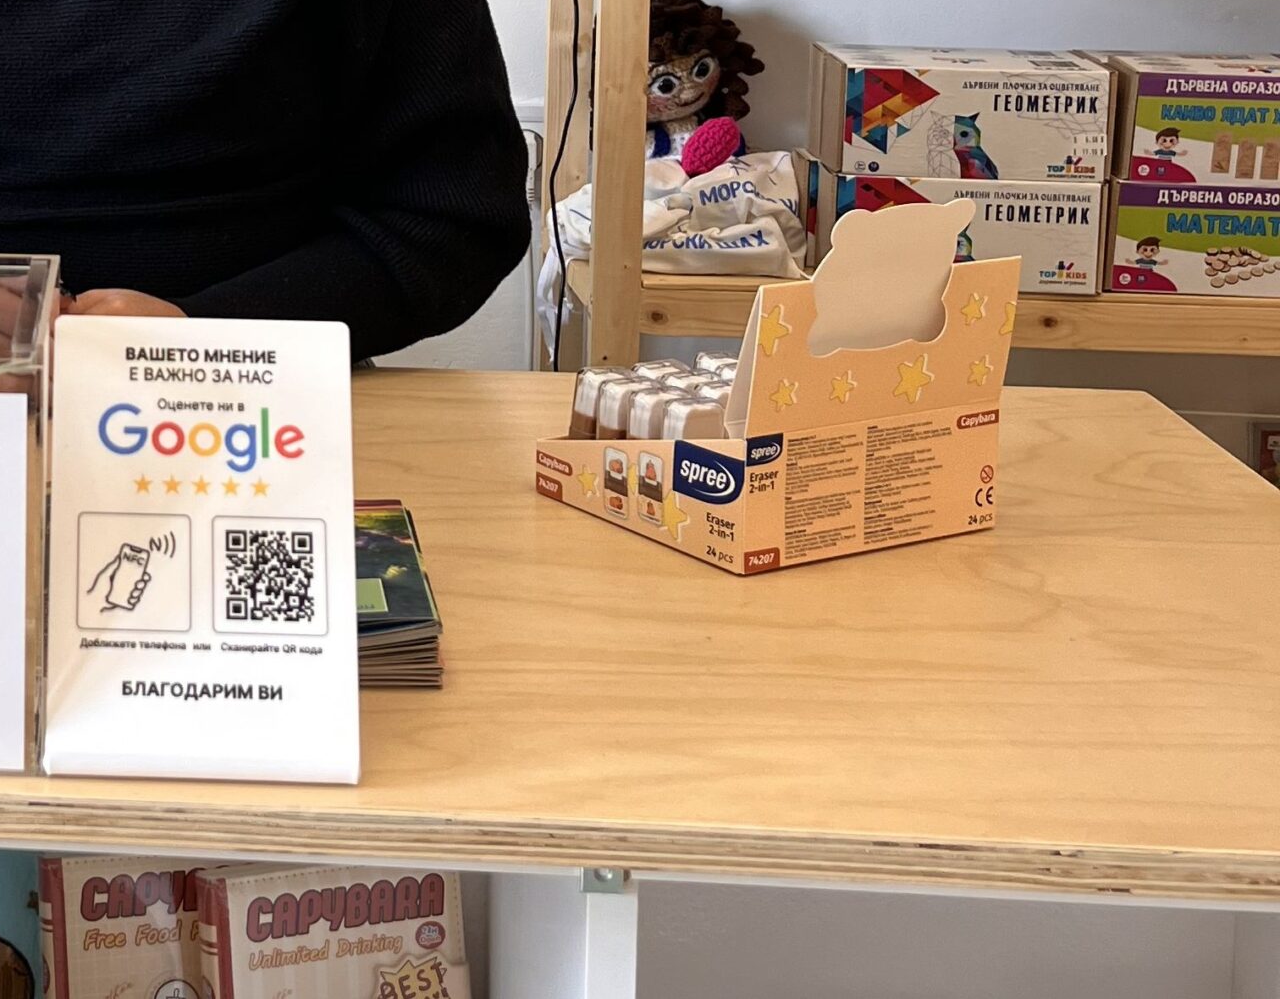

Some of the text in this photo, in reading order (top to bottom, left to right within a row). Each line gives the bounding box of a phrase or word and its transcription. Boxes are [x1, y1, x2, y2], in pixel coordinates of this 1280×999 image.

[962, 82, 1100, 92] ДЪРВЕНИ ПЛОЧКИ ЗА ОЦВЕТЯВАНЕ
[1166, 79, 1228, 94] ДЪРВЕНА
[993, 94, 1098, 114] ГЕОМЕТРИК
[1161, 104, 1216, 122] КАКВО
[1220, 107, 1269, 126] ЯДАТ
[1047, 165, 1065, 173] TOP
[953, 191, 1091, 203] ДЪРВЕНИ ПЛОЧКИ ЗА ОЦВЕТЯВАНЕ
[1157, 189, 1223, 205] ДЪРВЕНА
[985, 204, 1089, 225] ГЕОМЕТРИК
[1039, 270, 1056, 278] TOP
[125, 347, 276, 364] ВАШЕТО МНЕНИЕ
[129, 367, 273, 384] Е ВАЖНО ЗА НАС
[157, 398, 244, 412] Оценете ни в
[960, 412, 996, 427] Capybara
[98, 403, 305, 472] Google
[750, 444, 777, 460] spree
[538, 453, 570, 474] Capybara
[680, 460, 728, 490] spree
[749, 470, 779, 484] Eraser
[538, 478, 559, 493] 74207
[749, 482, 775, 494] 2-in-1
[706, 512, 736, 531] Eraser
[968, 514, 993, 525] 24 pcs
[709, 525, 734, 542] 2-in-1
[122, 553, 145, 566] NFC
[706, 545, 734, 564] 24 pcs
[748, 553, 775, 567] 74207
[80, 637, 211, 651] Доближете телефона или
[220, 642, 323, 656] Сканирайте QR кода
[121, 680, 283, 701] БЛАГОДАРИМ ВИ
[246, 872, 445, 943] CAPYBARA
[84, 928, 126, 951] Free
[135, 919, 182, 947] Food
[249, 935, 403, 971] Unlimited Drinking
[379, 962, 443, 999] BEST
